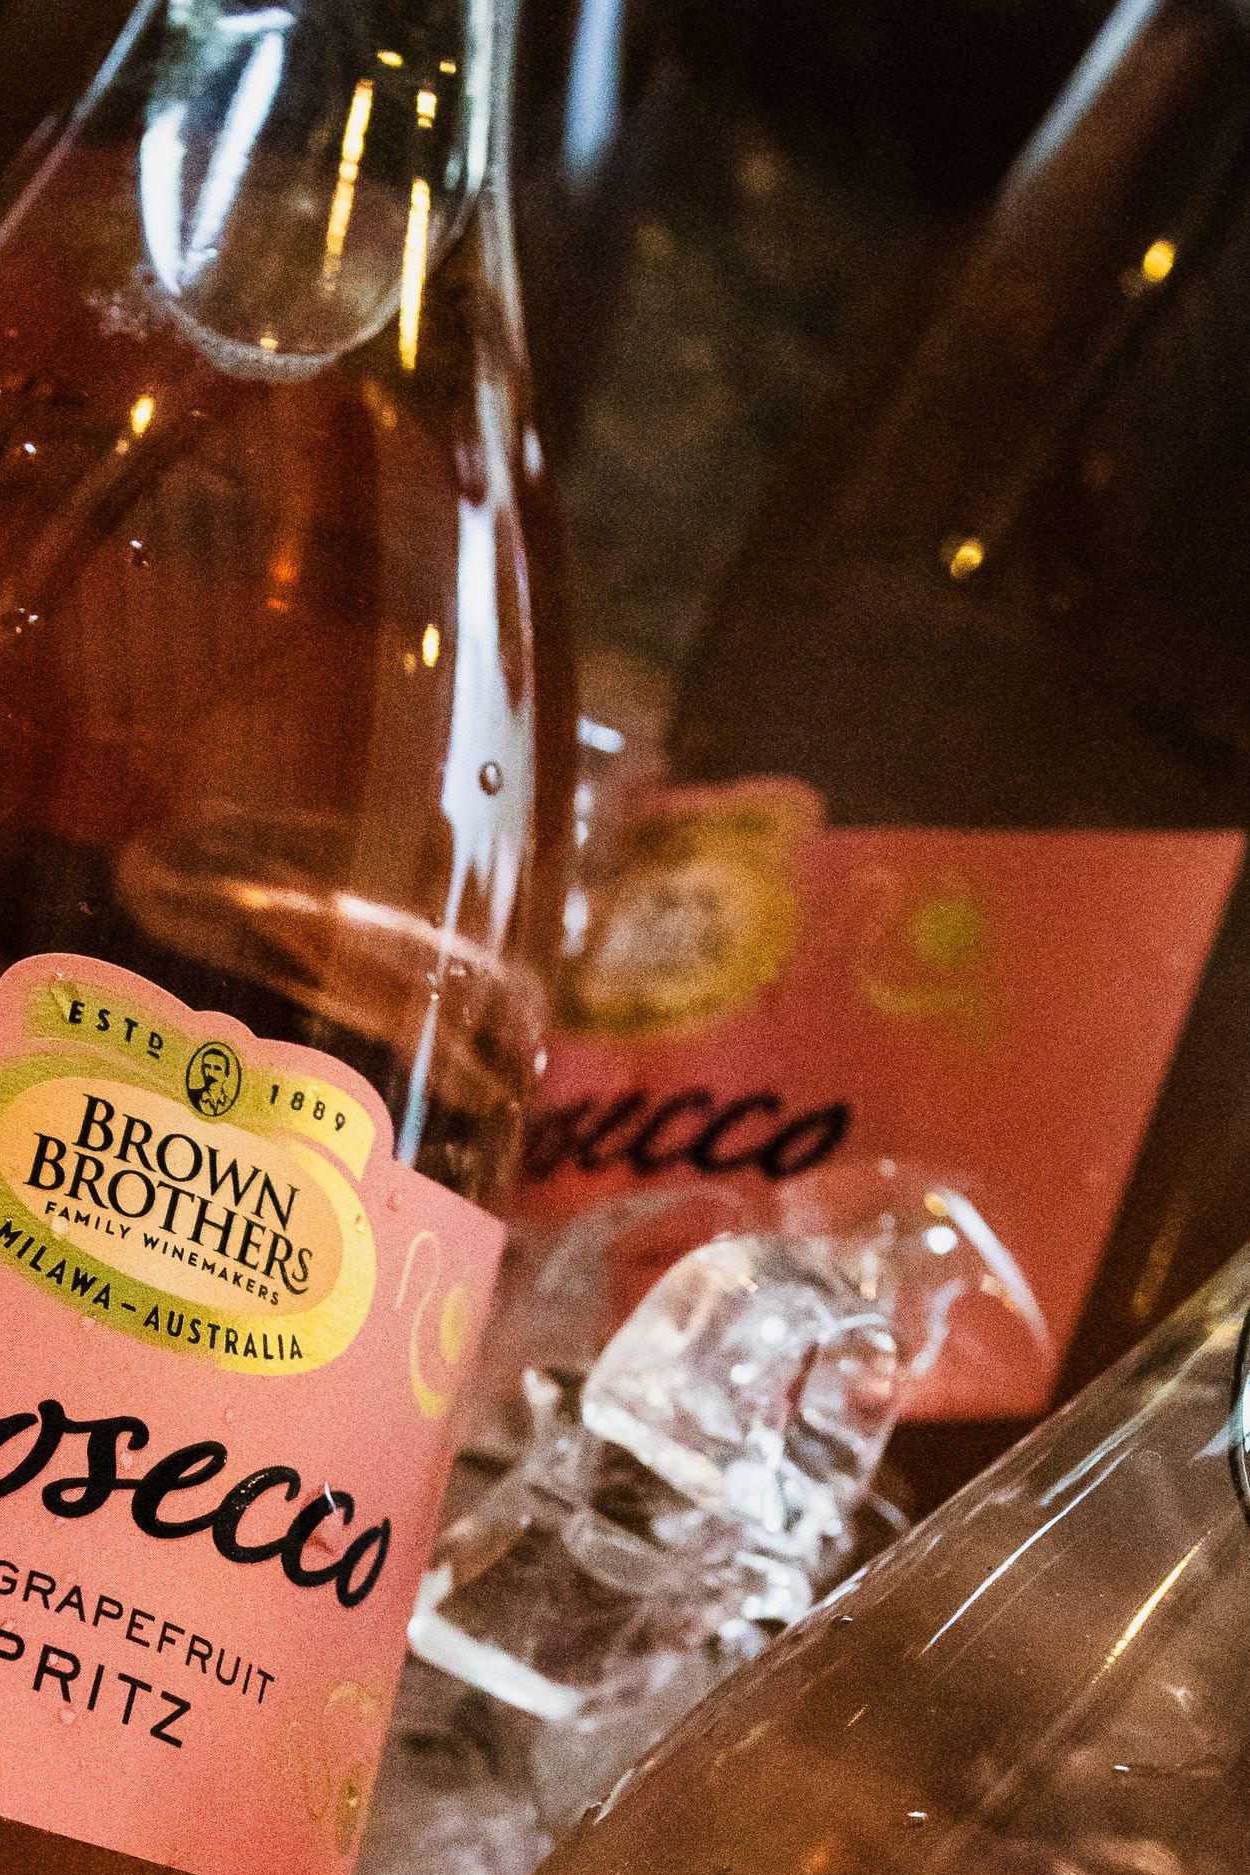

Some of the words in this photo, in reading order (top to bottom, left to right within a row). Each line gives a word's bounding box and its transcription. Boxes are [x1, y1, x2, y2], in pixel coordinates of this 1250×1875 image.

[71, 1092, 301, 1232] BROWN
[269, 1084, 347, 1132] 1889
[23, 1131, 314, 1295] BROTHERS
[44, 1200, 131, 1240] FAMILY
[143, 1231, 281, 1306] WINEMAKERS
